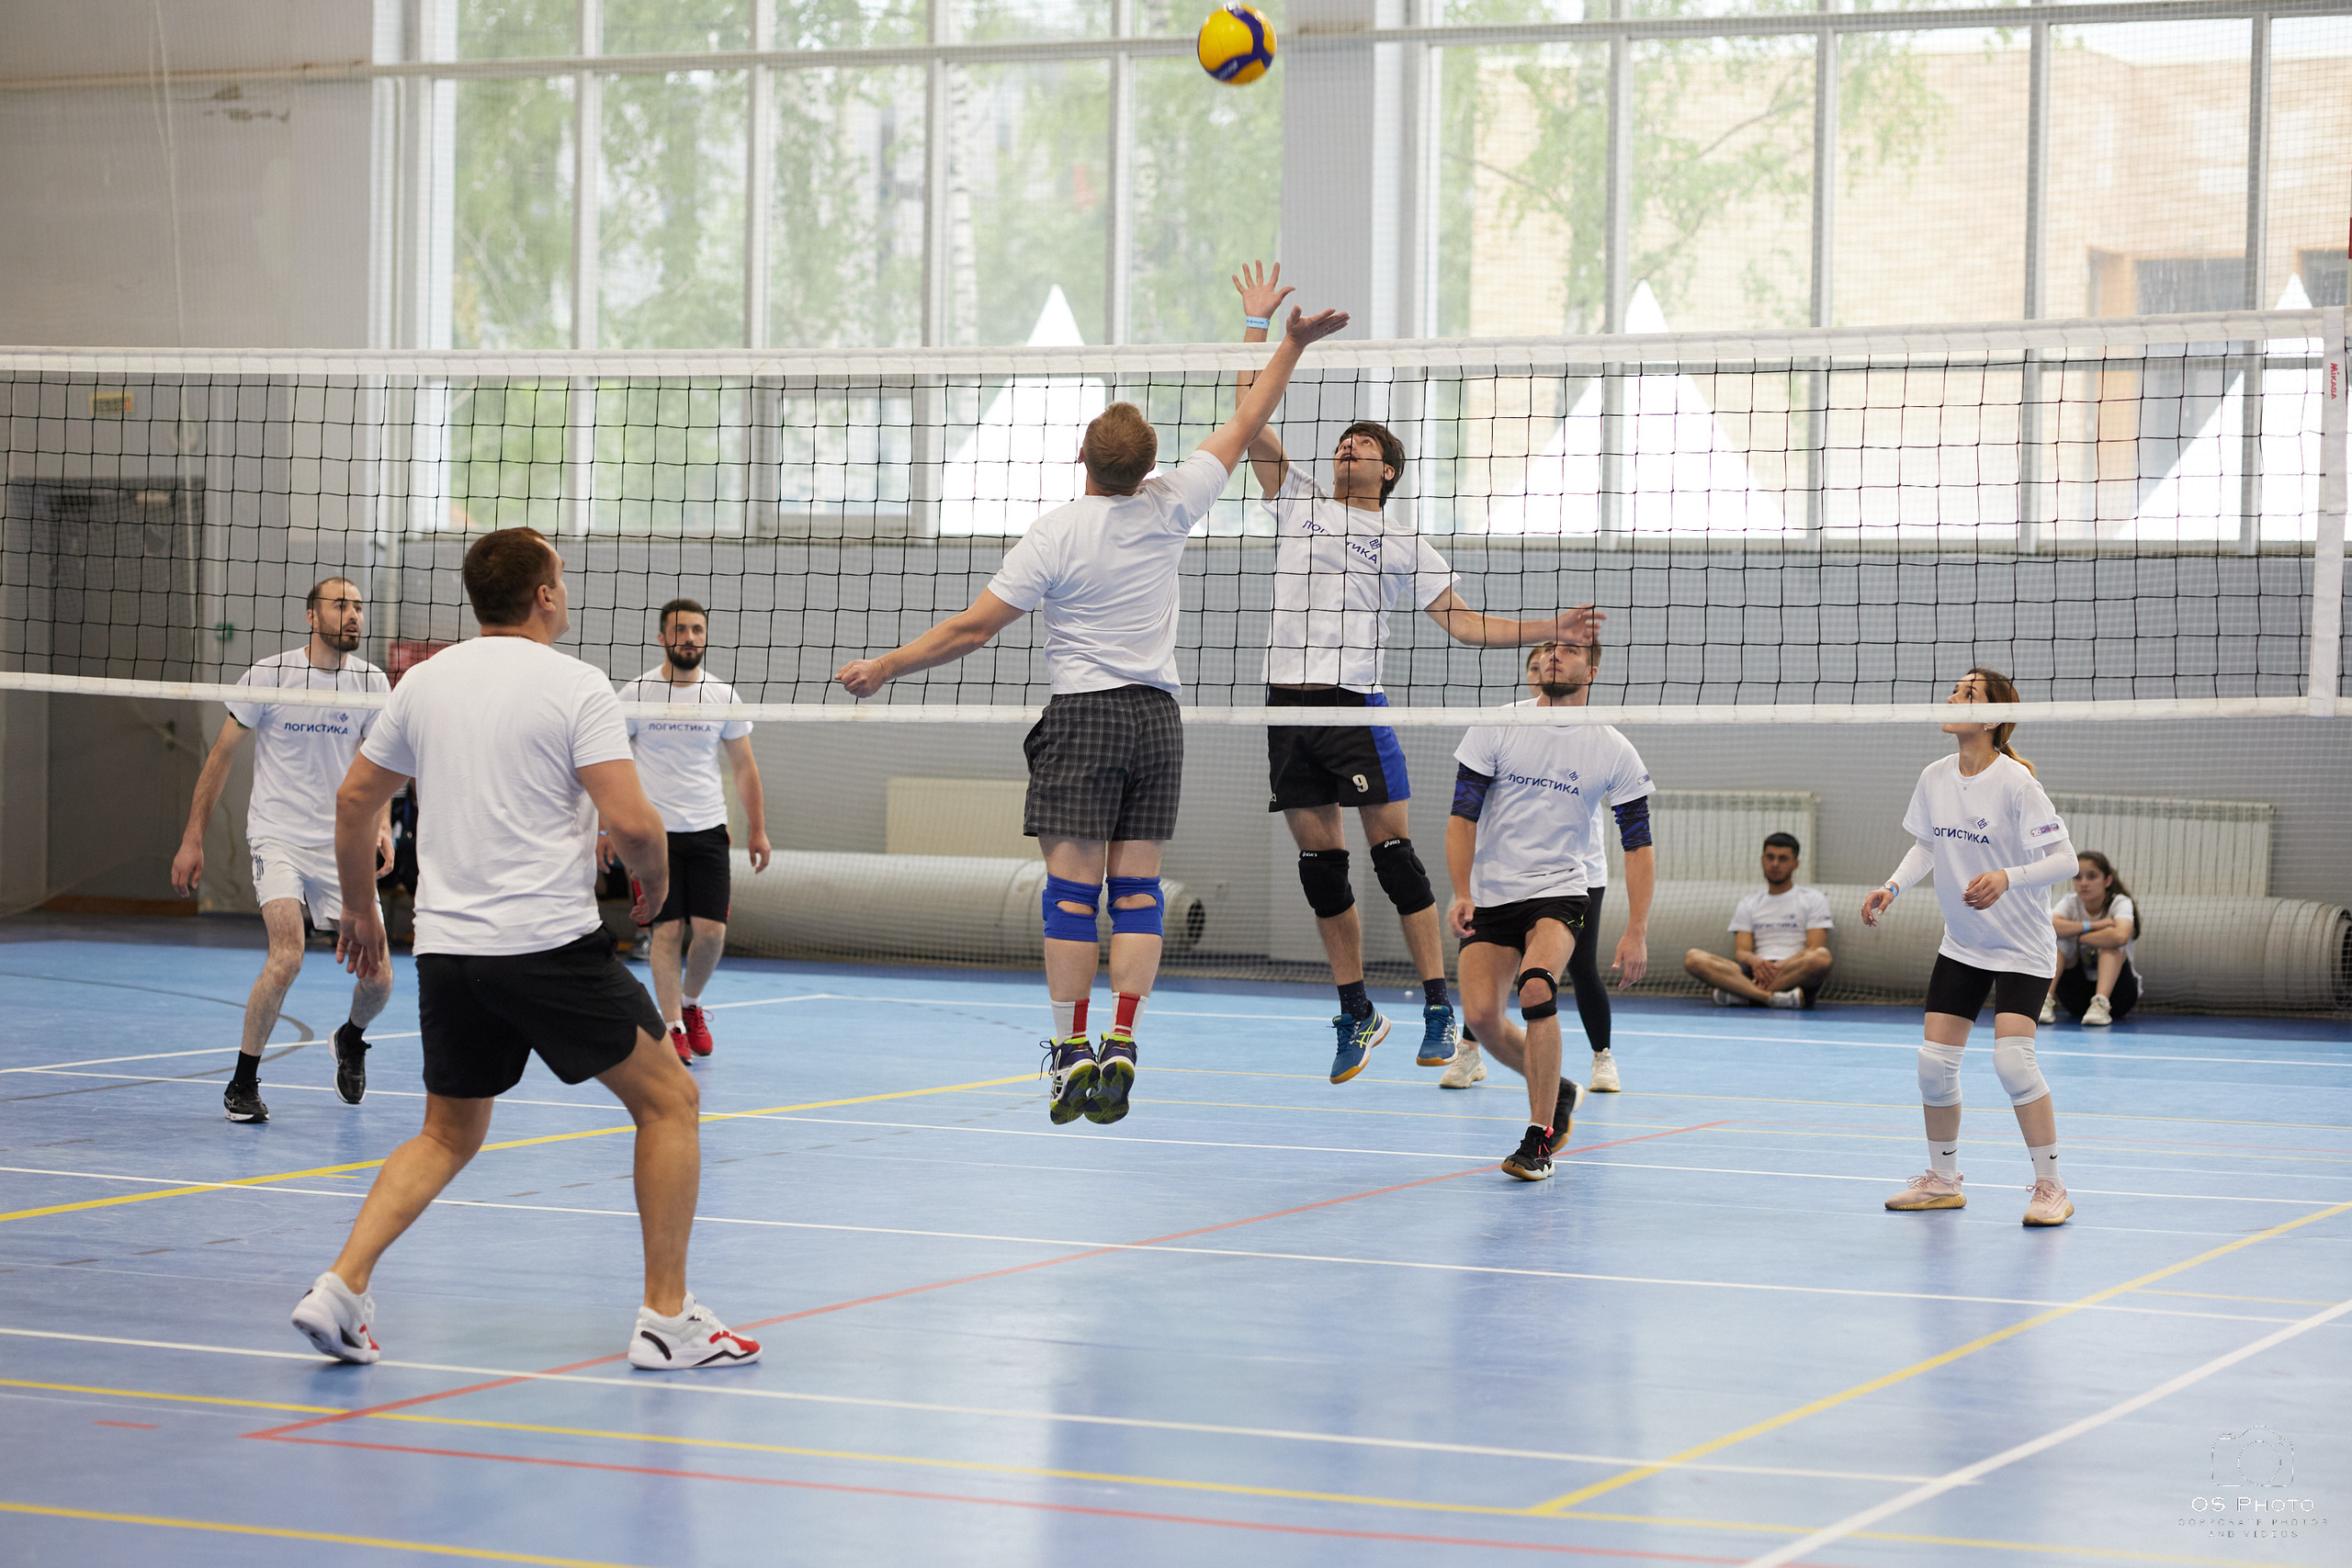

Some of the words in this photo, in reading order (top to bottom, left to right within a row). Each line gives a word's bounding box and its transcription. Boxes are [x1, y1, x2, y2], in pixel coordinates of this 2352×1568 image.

[284, 722, 348, 735] ЛОГИСТИКА
[649, 723, 711, 731] ЛОГИСТИКА
[1352, 773, 1369, 793] 9
[1508, 773, 1579, 795] ЛОГИСТИКА
[1932, 827, 1990, 844] ОГИСТИКА
